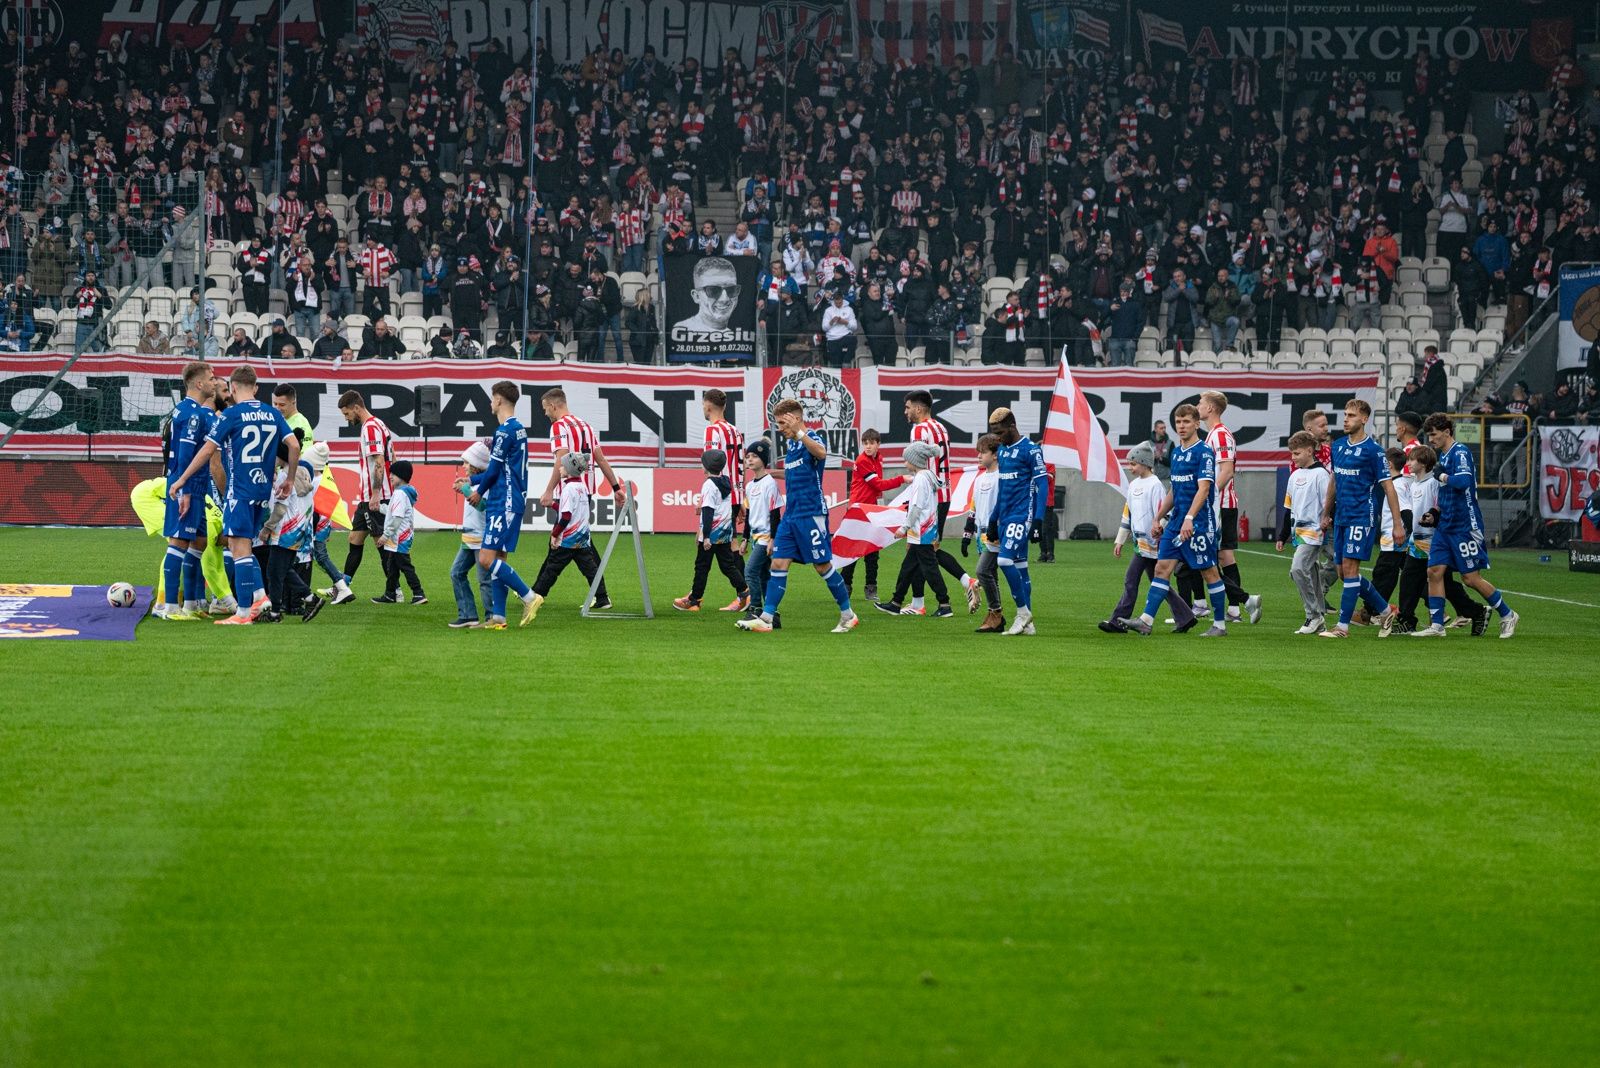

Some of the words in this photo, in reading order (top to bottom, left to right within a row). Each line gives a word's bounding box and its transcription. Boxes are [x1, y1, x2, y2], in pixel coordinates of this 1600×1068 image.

[1294, 5, 1351, 14] przyczyn
[1365, 4, 1413, 12] miliona
[1417, 4, 1477, 14] powodów
[1187, 15, 1528, 62] ANDRYCHÓW
[671, 327, 756, 343] Grzesiu
[676, 344, 711, 353] 28.01.1993
[719, 344, 753, 353] 10.07.2024
[241, 409, 275, 422] MOŃKA
[880, 389, 1358, 447] KIBICE
[241, 424, 278, 464] 27
[489, 515, 503, 532] 14
[1005, 523, 1025, 540] 88
[810, 529, 822, 546] 2
[1349, 525, 1364, 541] 15
[1190, 535, 1207, 552] 43
[1459, 540, 1479, 558] 99
